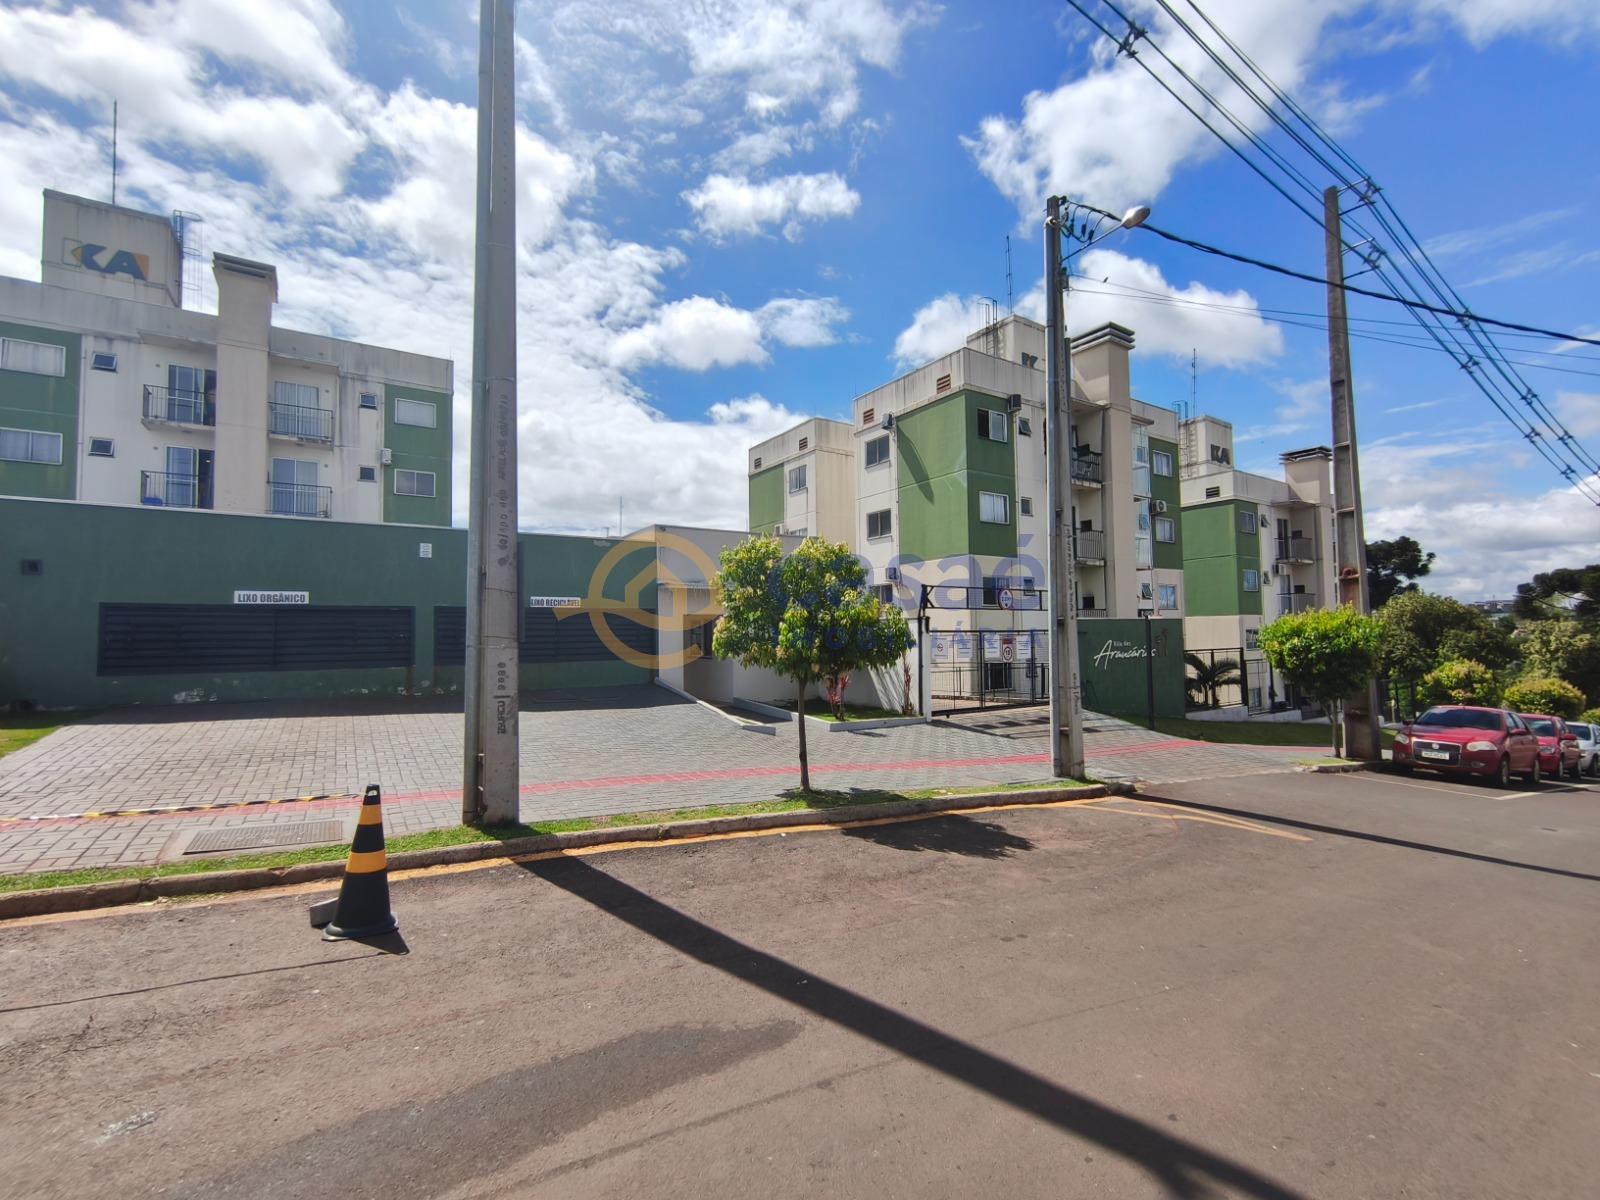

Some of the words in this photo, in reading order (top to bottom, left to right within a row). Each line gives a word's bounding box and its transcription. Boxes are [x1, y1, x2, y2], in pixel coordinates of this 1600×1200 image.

[238, 593, 258, 602] LIXO
[260, 592, 306, 603] ORGÂNICO
[531, 598, 545, 606] LIXO
[1093, 639, 1157, 670] Araucáris
